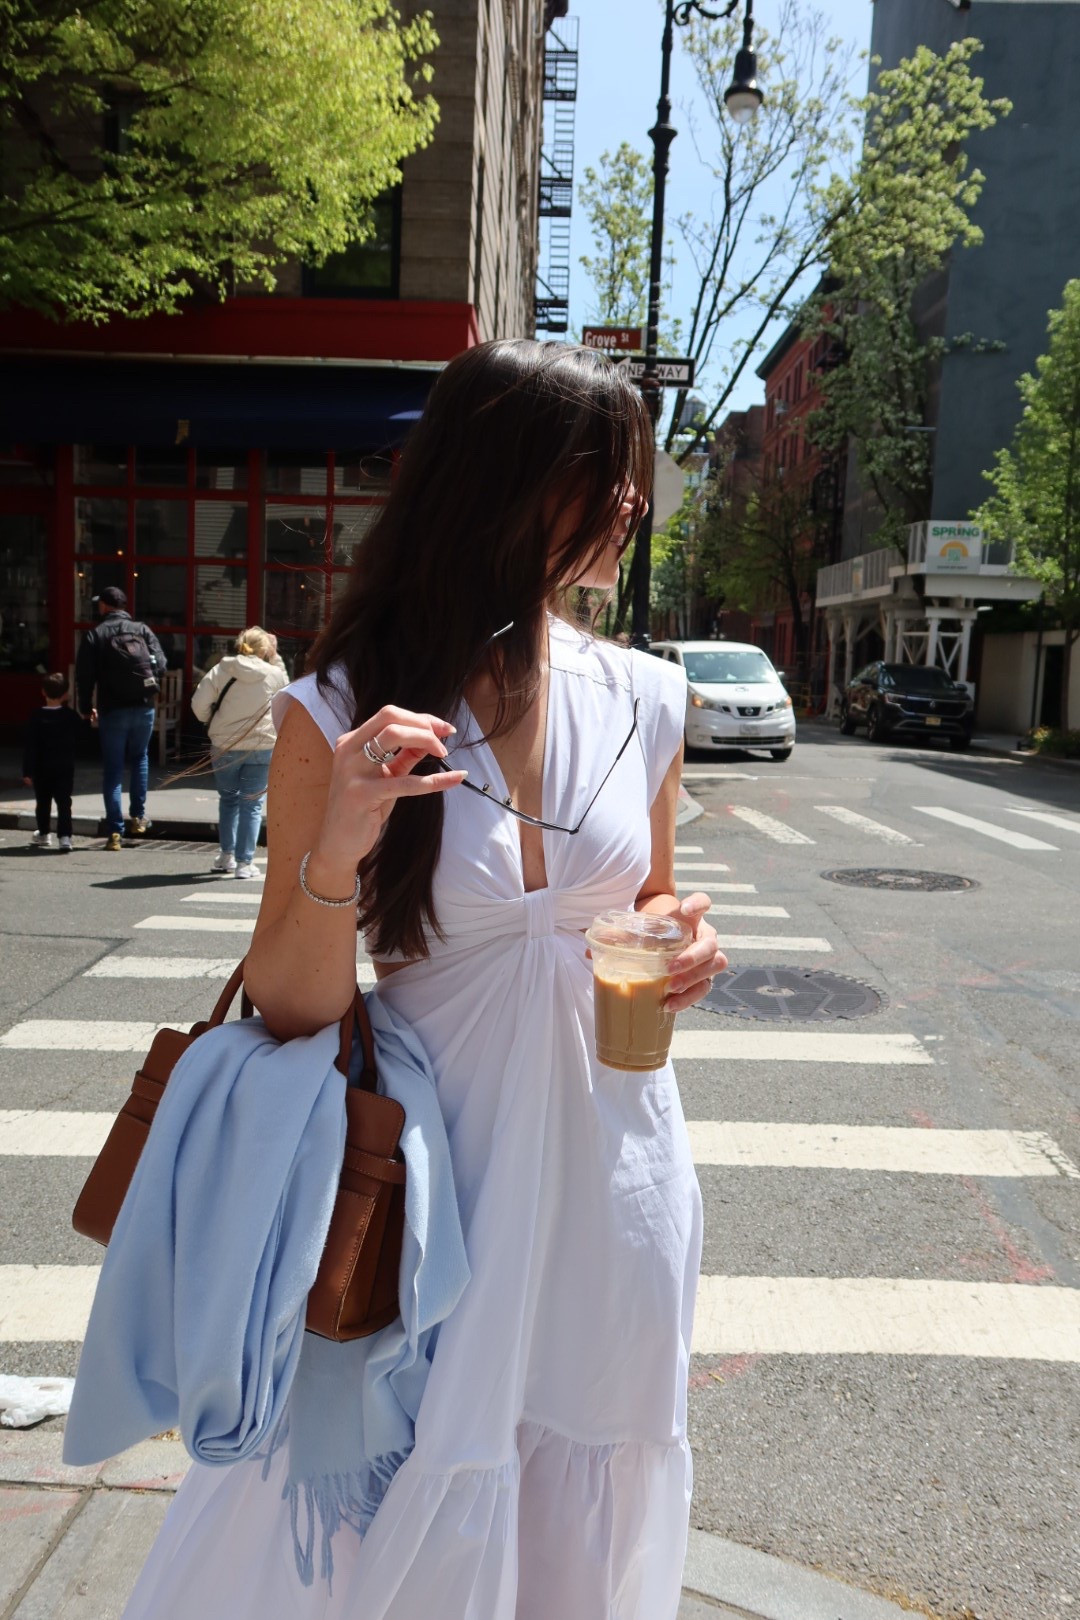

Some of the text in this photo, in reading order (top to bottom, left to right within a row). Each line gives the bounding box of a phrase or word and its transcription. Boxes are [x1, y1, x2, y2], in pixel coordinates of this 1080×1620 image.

[585, 331, 629, 348] Grove St
[619, 363, 684, 378] ONE WAY
